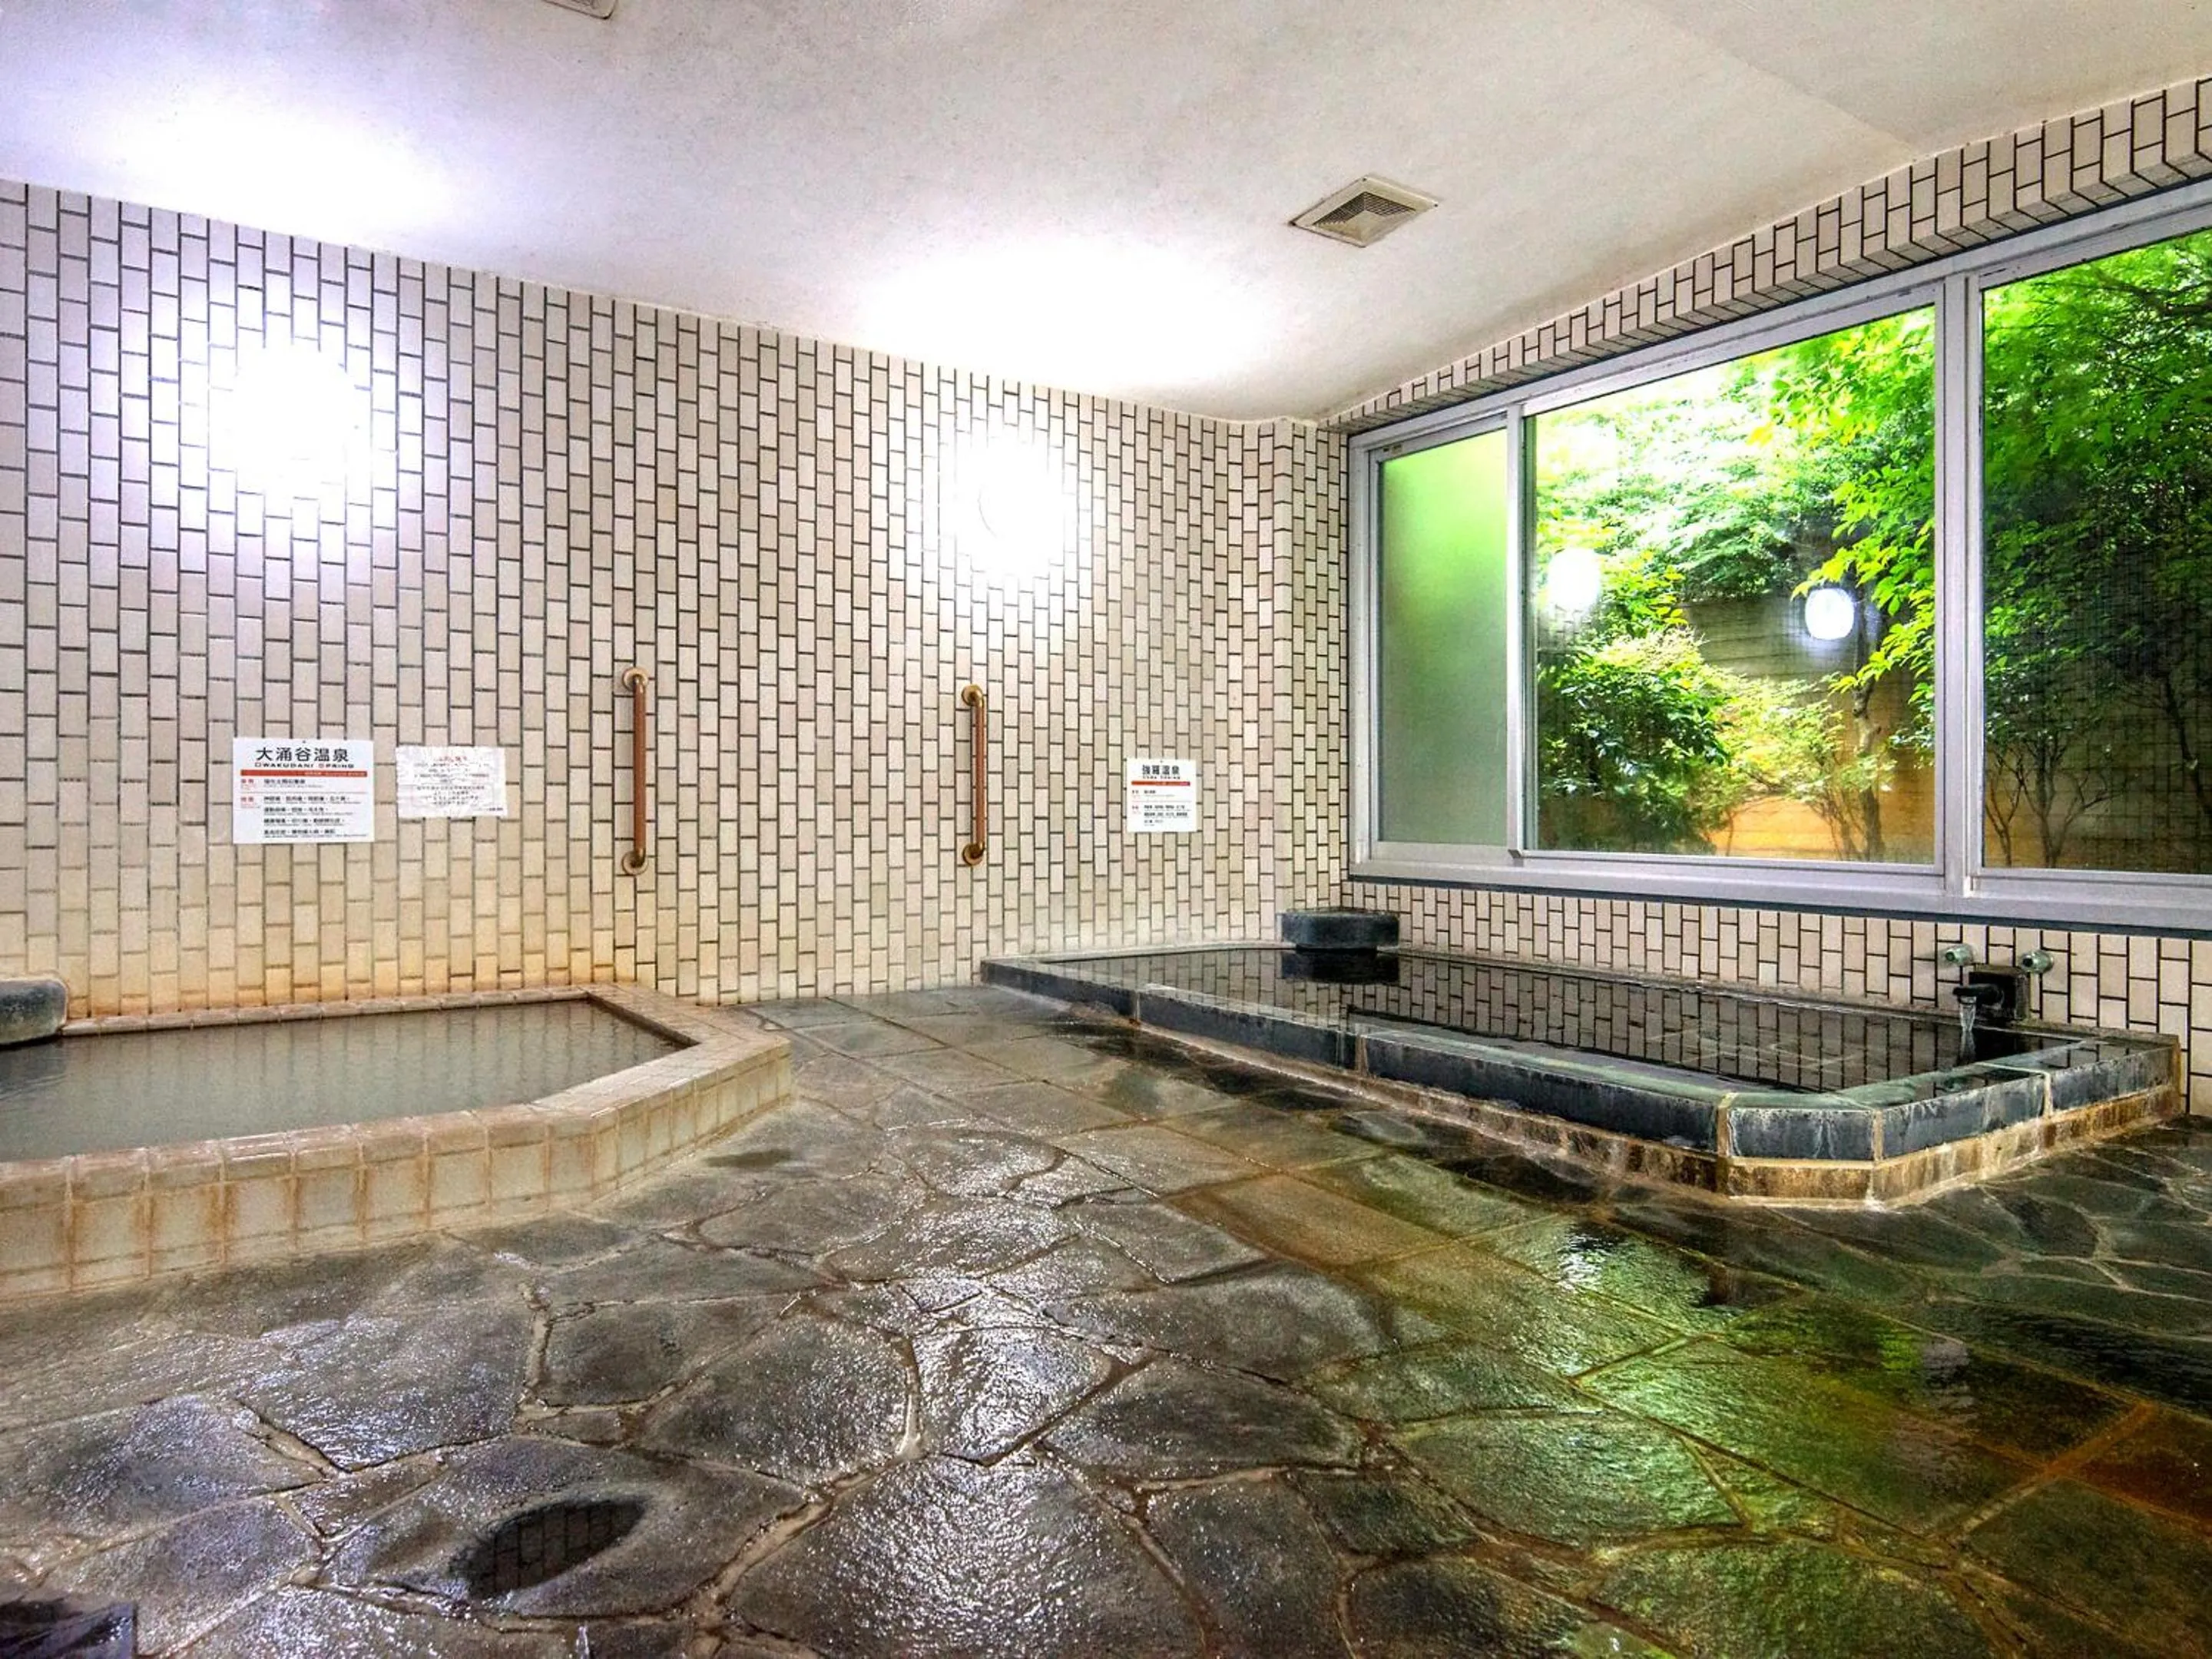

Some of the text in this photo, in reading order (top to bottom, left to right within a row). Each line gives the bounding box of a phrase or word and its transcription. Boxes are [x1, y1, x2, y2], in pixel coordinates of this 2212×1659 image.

[256, 747, 349, 763] 大涌谷温泉
